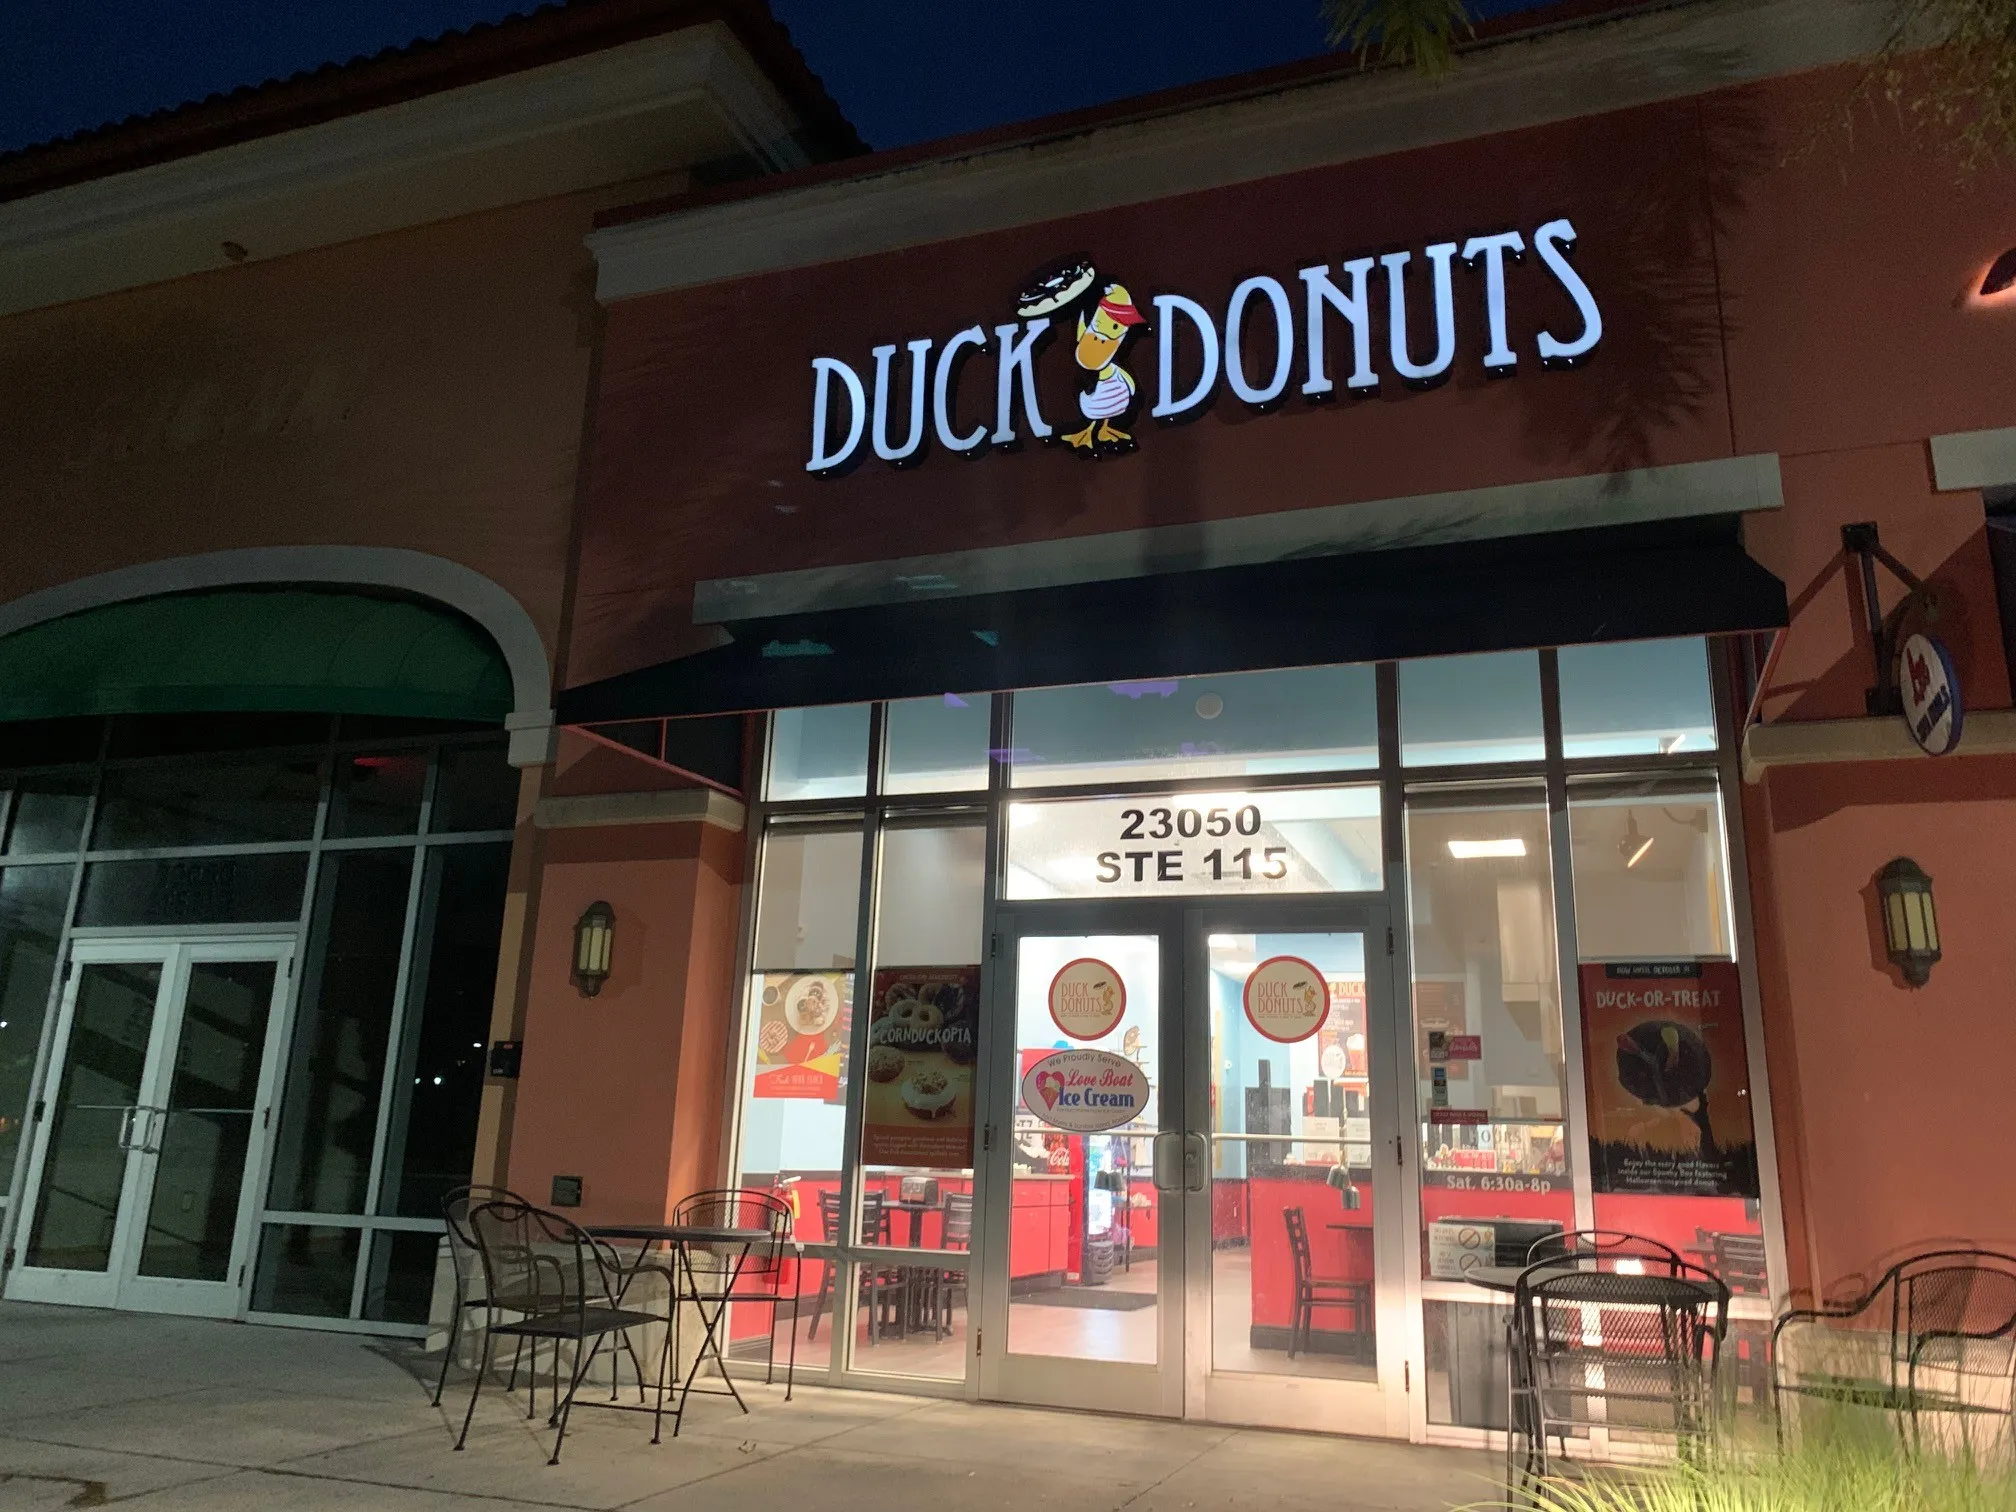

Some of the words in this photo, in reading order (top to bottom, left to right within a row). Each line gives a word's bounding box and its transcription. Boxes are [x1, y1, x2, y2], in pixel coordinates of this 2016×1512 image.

[805, 317, 1053, 473] DUCK
[1151, 218, 1604, 420] DONUTS
[1119, 805, 1262, 840] 23050
[1095, 850, 1184, 883] STE
[1203, 846, 1288, 880] 115
[1061, 982, 1089, 998] DUCK
[1257, 981, 1288, 998] DUCK
[1060, 997, 1103, 1013] DONUTS
[1257, 998, 1304, 1013] DONUTS
[1595, 990, 1722, 1009] DUCK-OR-TREAT
[880, 1027, 972, 1045] CORNDUCKOPIA
[1048, 1058, 1062, 1068] We
[1063, 1053, 1096, 1063] Proudly
[1098, 1054, 1122, 1068] Serve
[1066, 1069, 1097, 1087] Love
[1099, 1069, 1134, 1088] Boat
[1059, 1086, 1081, 1106] Ice
[1084, 1088, 1135, 1107] Cream
[1447, 1175, 1476, 1190] Sat.
[1481, 1176, 1551, 1196] 6:30a-8p
